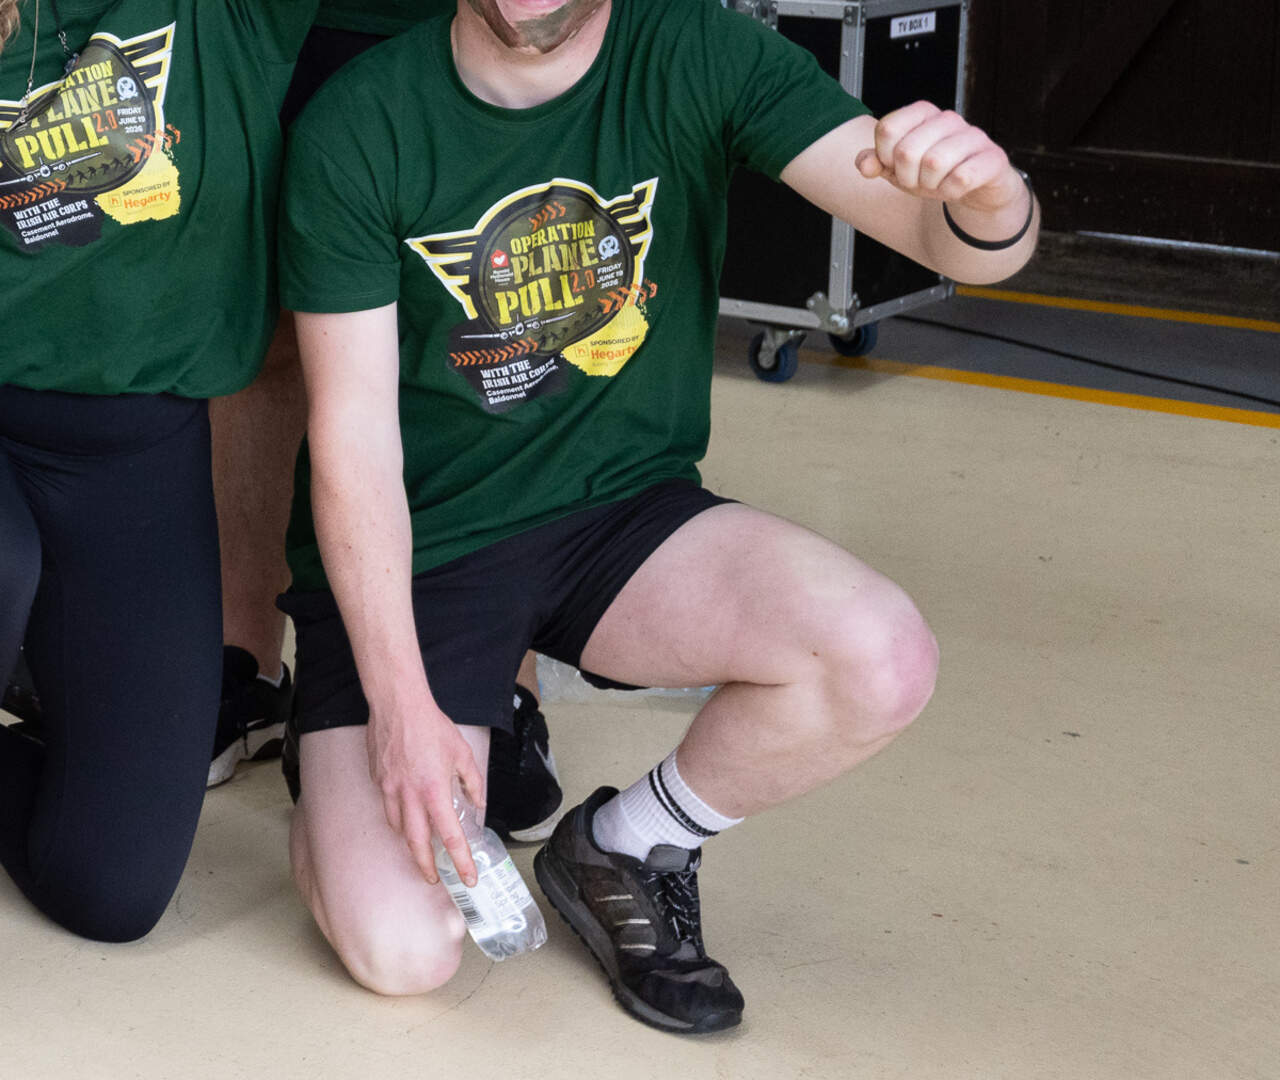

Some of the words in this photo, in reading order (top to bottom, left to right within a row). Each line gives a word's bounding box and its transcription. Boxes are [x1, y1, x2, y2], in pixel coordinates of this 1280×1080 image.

[898, 21, 908, 33] TV
[909, 19, 922, 32] BOX
[93, 109, 118, 133] 2.0
[116, 106, 142, 116] FRIDAY
[118, 116, 138, 126] JUNE
[139, 115, 146, 123] 19
[124, 124, 144, 134] 2026
[14, 116, 110, 169] PULL
[122, 184, 160, 197] SPONSORED
[161, 181, 171, 189] BY
[123, 190, 172, 210] Hegarty
[13, 203, 44, 221] WITH
[41, 197, 61, 215] THE
[16, 214, 42, 231] IRISH
[41, 207, 60, 222] AIR
[58, 199, 89, 217] CORPS
[21, 222, 55, 237] Casement
[55, 211, 94, 228] Aerodrome,
[23, 229, 59, 244] Baldonnel
[510, 220, 596, 255] OPERATION
[511, 238, 599, 285] PLANE
[570, 269, 595, 294] 2.0
[495, 274, 584, 325] PULL
